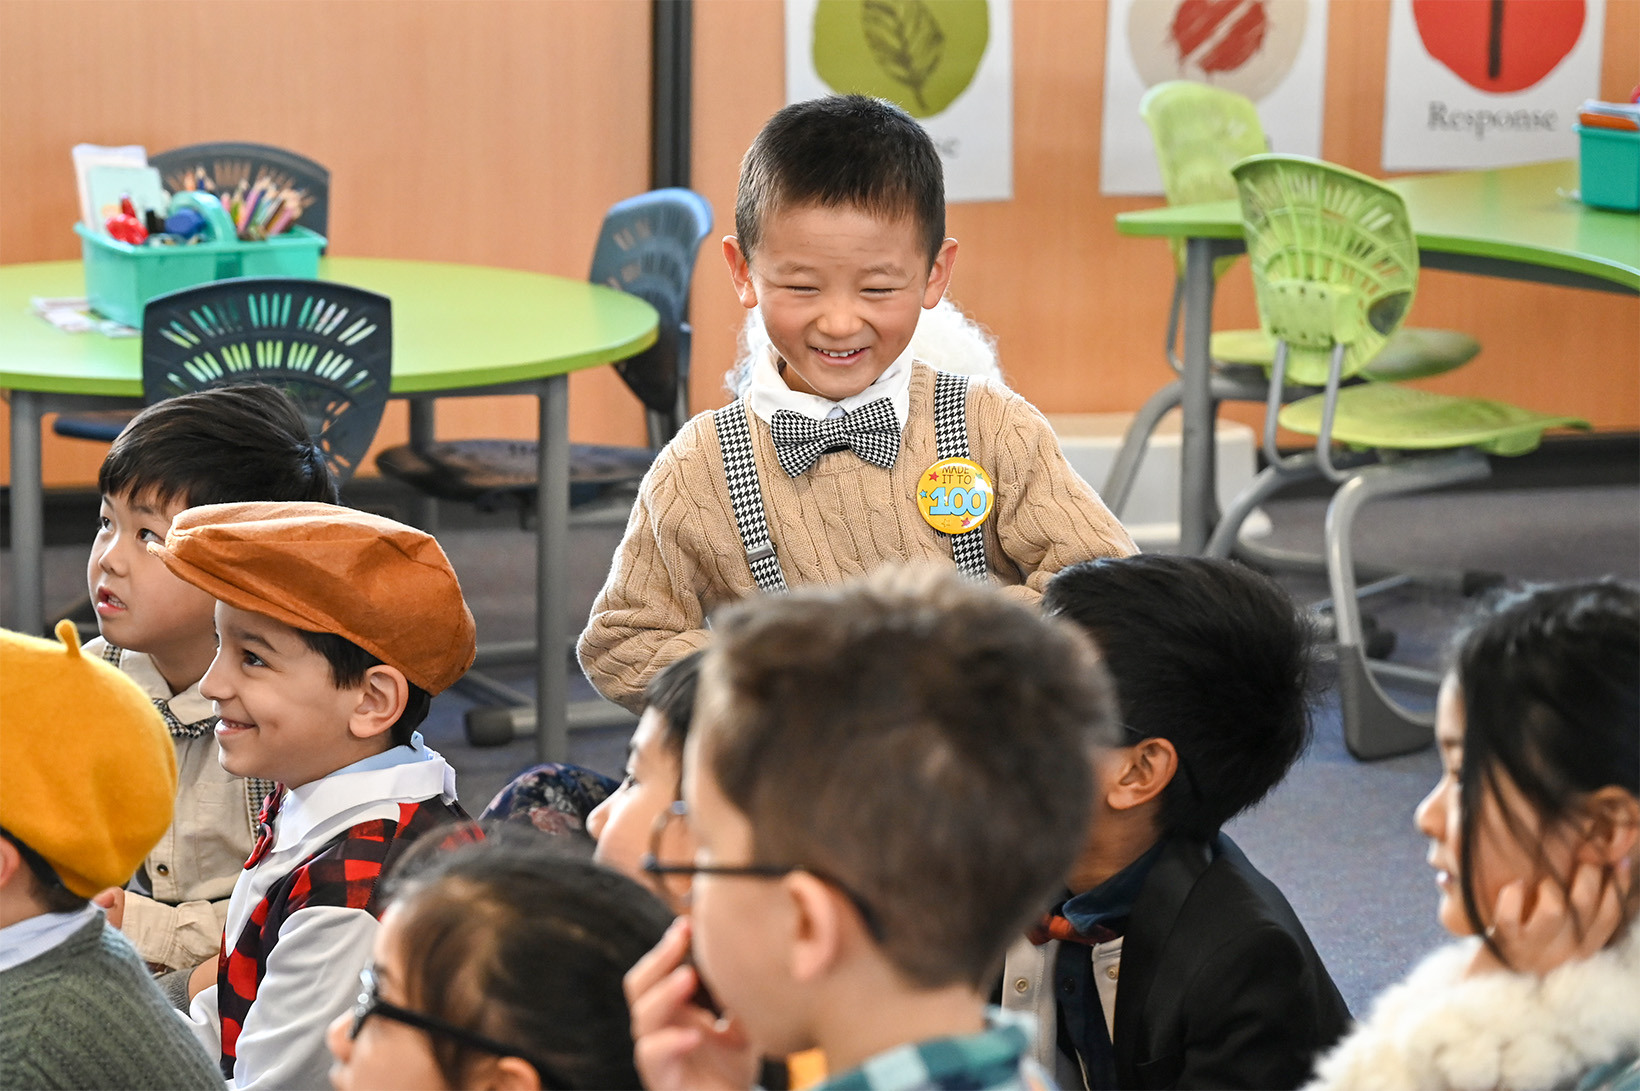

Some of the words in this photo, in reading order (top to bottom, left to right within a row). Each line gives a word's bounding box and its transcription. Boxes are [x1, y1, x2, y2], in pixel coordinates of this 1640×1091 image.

[1428, 101, 1558, 139] Response
[942, 466, 970, 474] MADE
[942, 475, 954, 484] IT
[957, 475, 972, 484] TO
[929, 487, 987, 516] 100
